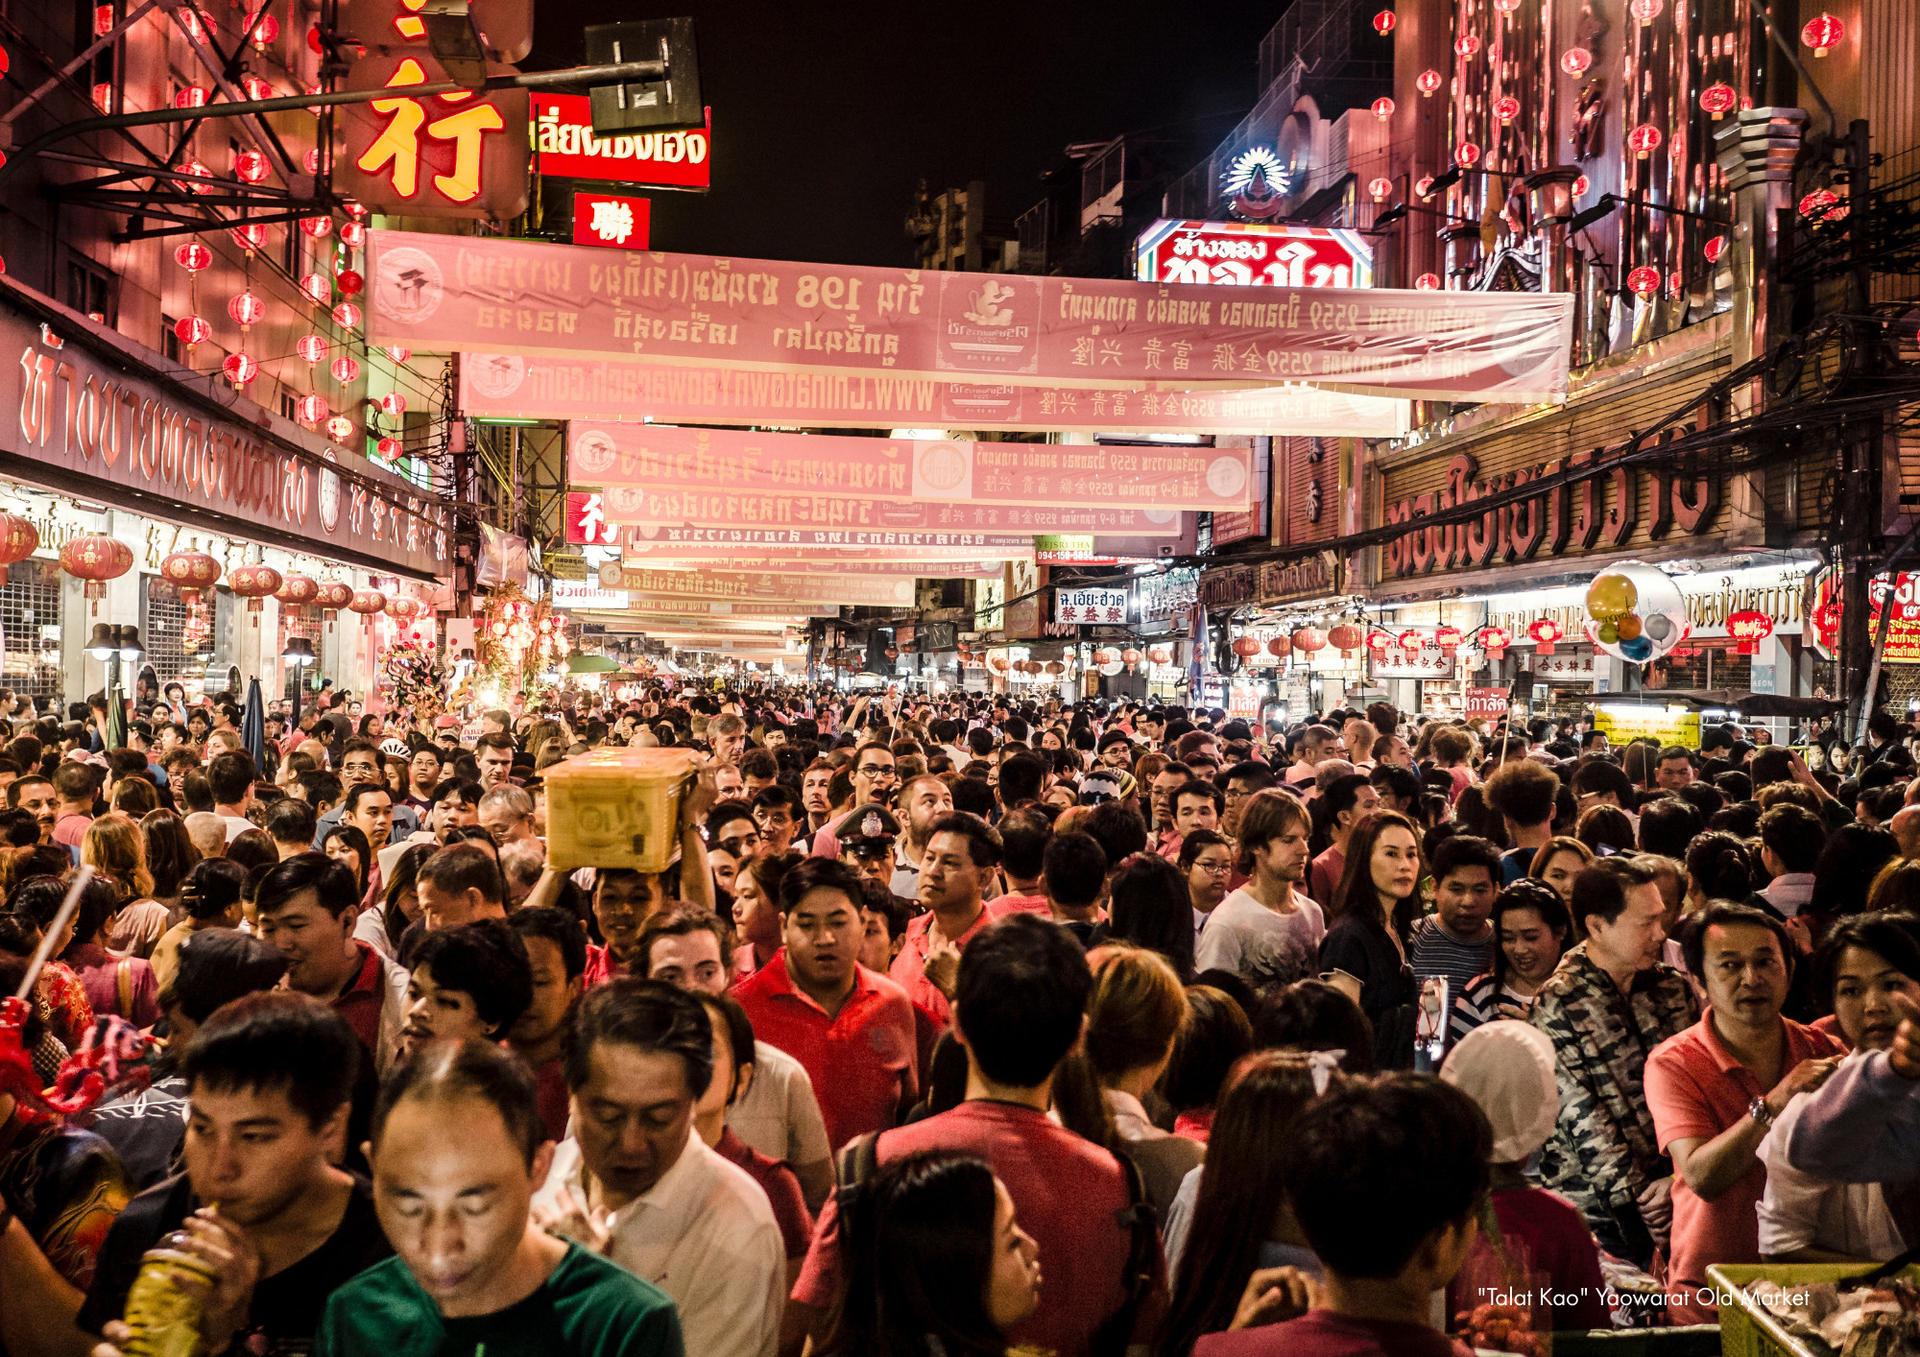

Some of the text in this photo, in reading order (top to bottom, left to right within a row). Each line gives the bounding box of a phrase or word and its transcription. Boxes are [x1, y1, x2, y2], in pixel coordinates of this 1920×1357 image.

[356, 58, 506, 205] 行
[592, 200, 648, 246] 聯
[1172, 231, 1267, 259] ห้างทอง
[1752, 679, 1772, 688] AEON
[1466, 693, 1507, 712] เกาลัด
